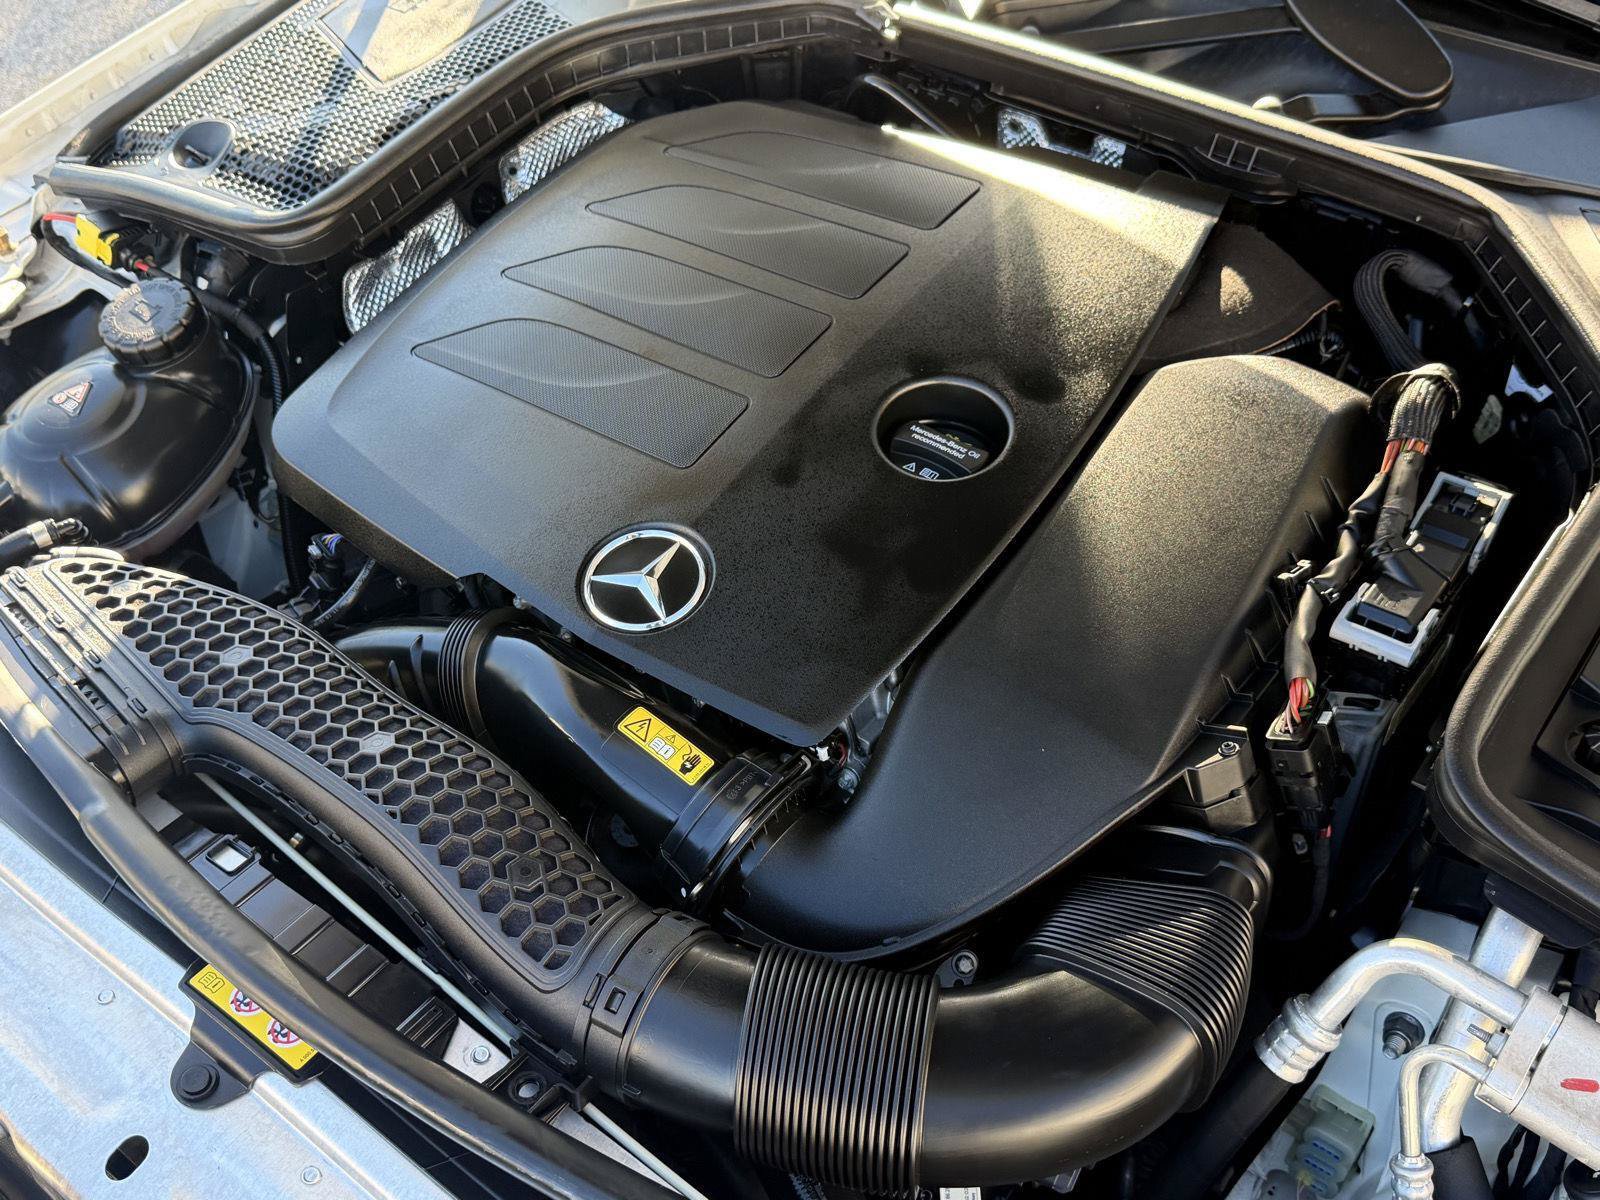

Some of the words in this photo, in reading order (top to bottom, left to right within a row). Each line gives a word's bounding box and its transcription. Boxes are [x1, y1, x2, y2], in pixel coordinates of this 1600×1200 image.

[910, 425, 968, 454] Mercedes-Benz
[968, 450, 981, 459] Oil
[911, 433, 965, 460] recommended
